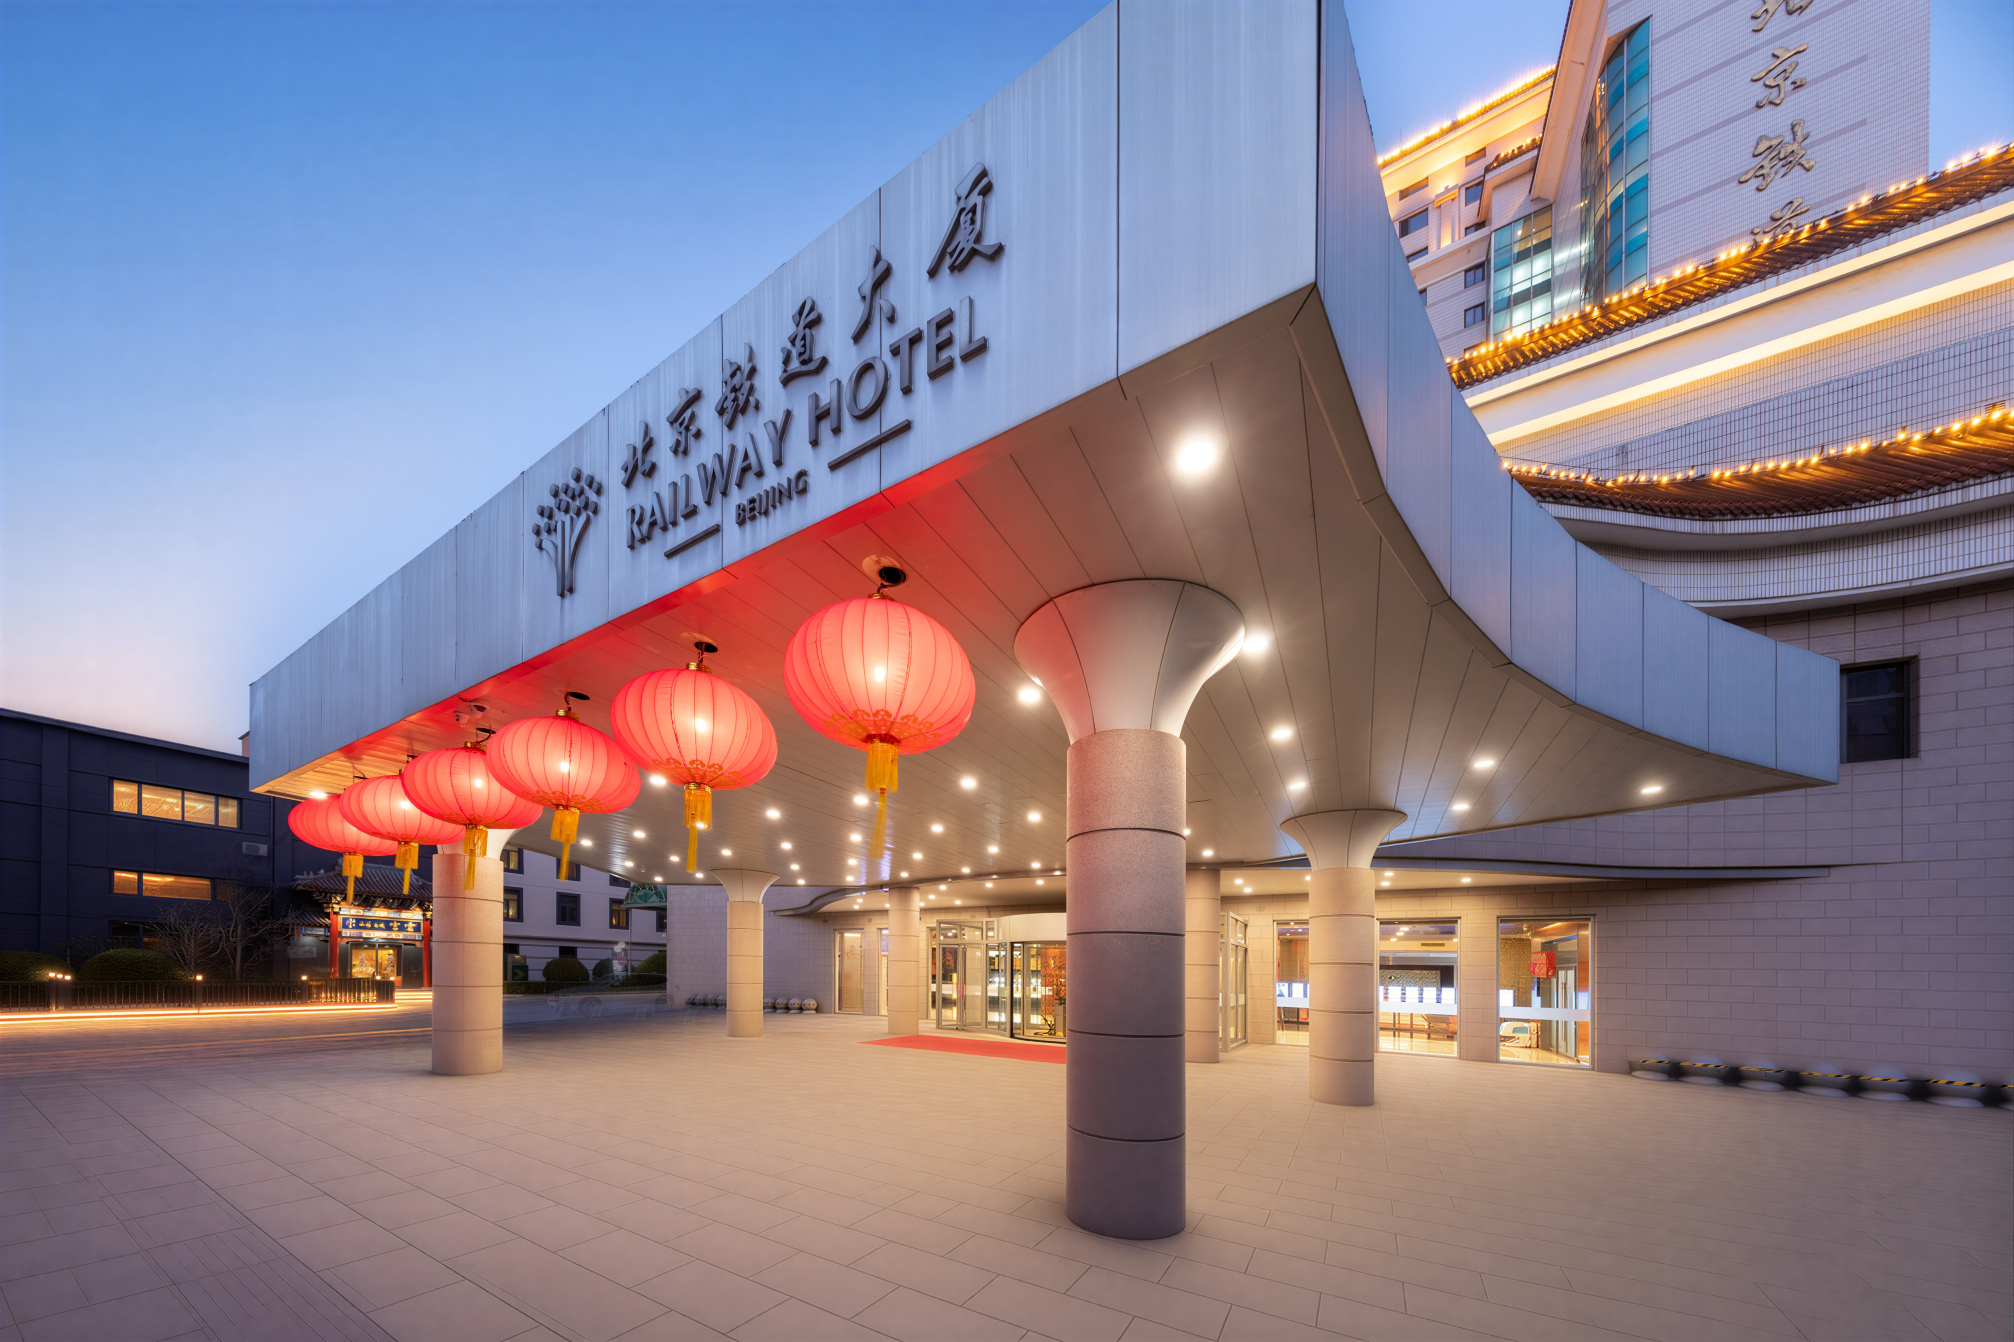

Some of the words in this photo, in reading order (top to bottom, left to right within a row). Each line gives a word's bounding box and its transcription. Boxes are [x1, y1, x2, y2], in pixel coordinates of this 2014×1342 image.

[626, 408, 792, 550] RAILWAY
[808, 296, 989, 446] HOTEL
[735, 469, 809, 526] BEIJING
